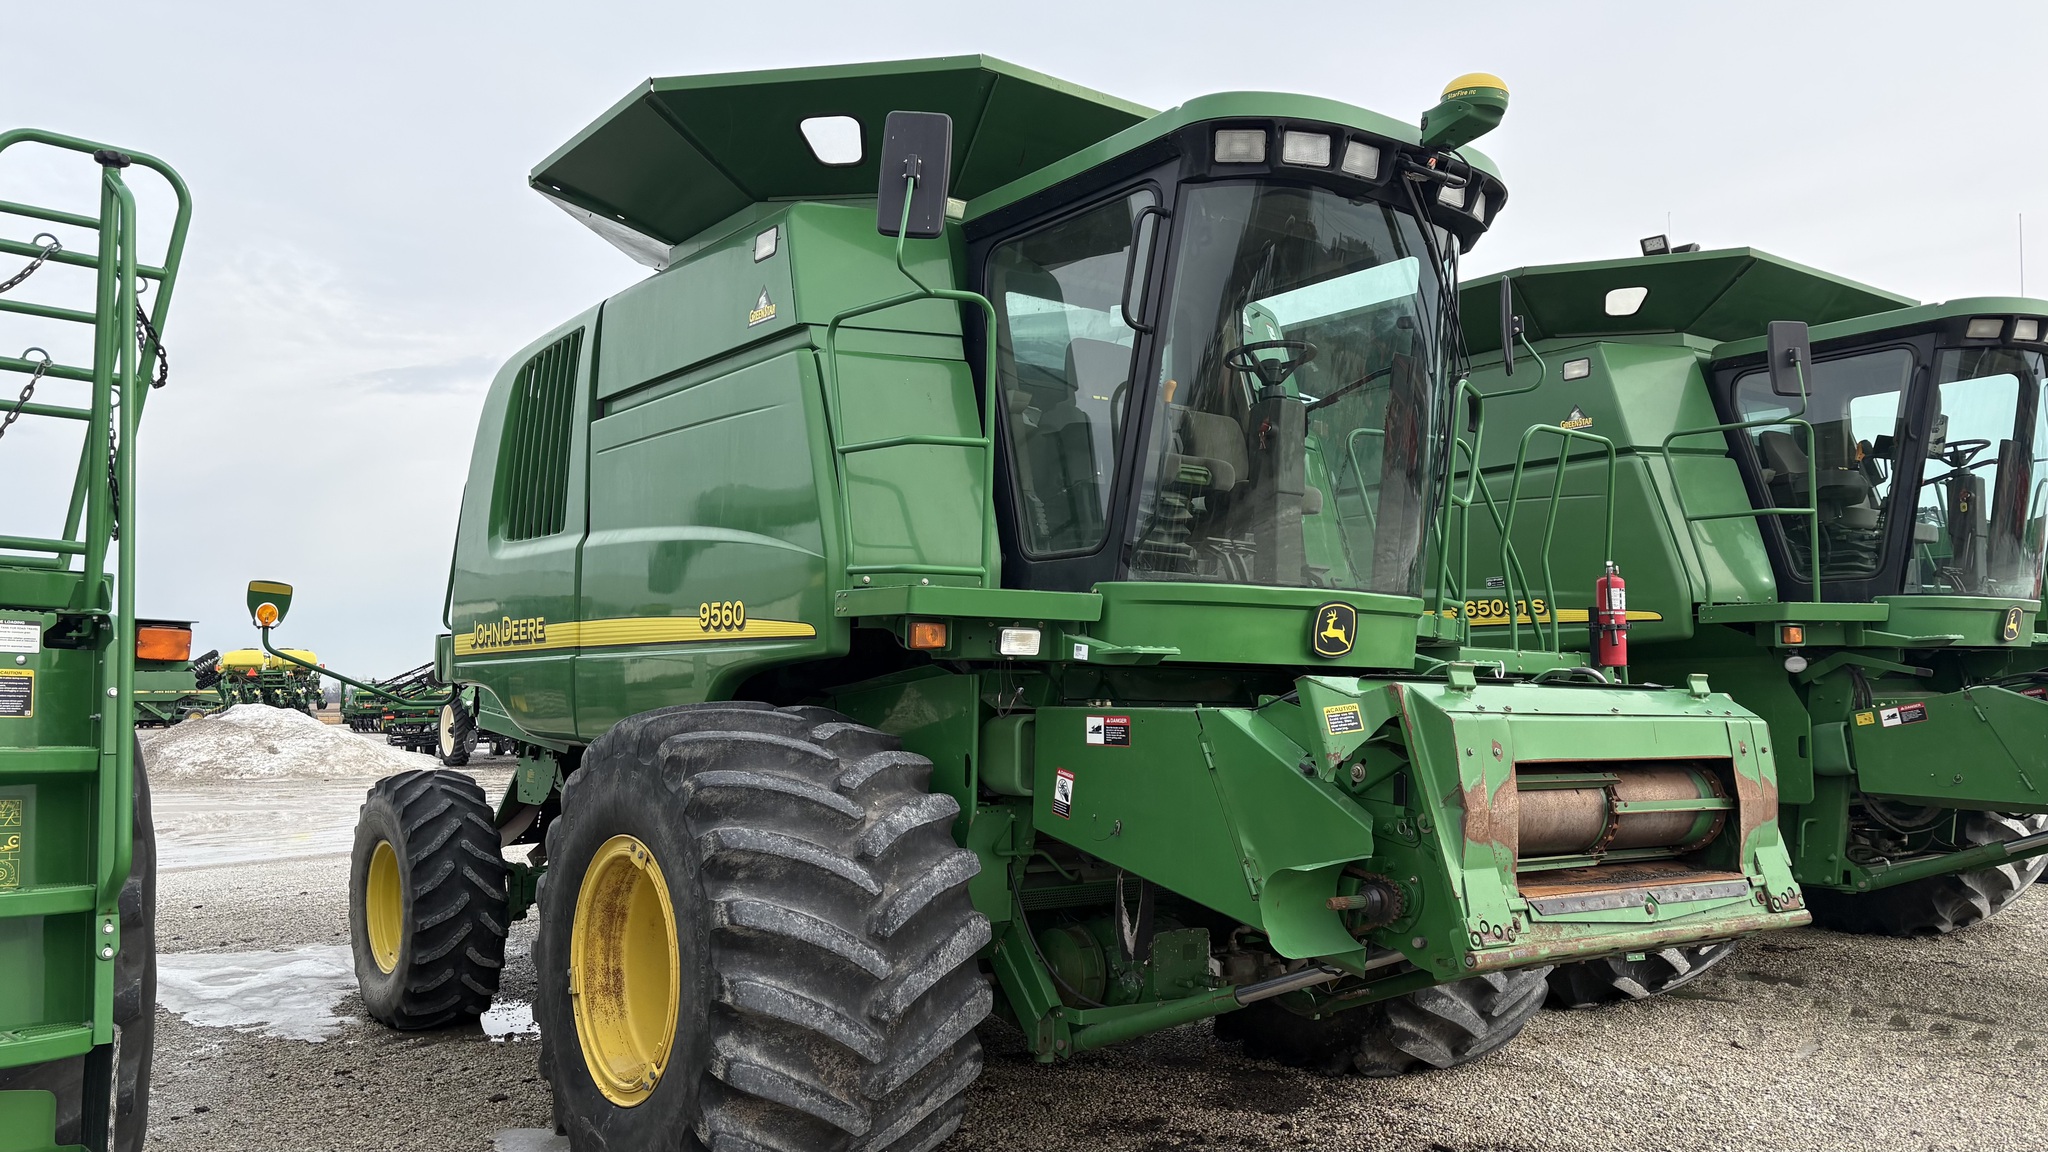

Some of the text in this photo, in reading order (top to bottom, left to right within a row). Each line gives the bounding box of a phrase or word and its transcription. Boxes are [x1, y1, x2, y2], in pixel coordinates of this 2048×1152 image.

[470, 615, 546, 648] JOHN DEERE
[699, 600, 746, 632] 9560
[1330, 705, 1357, 713] CAUTION
